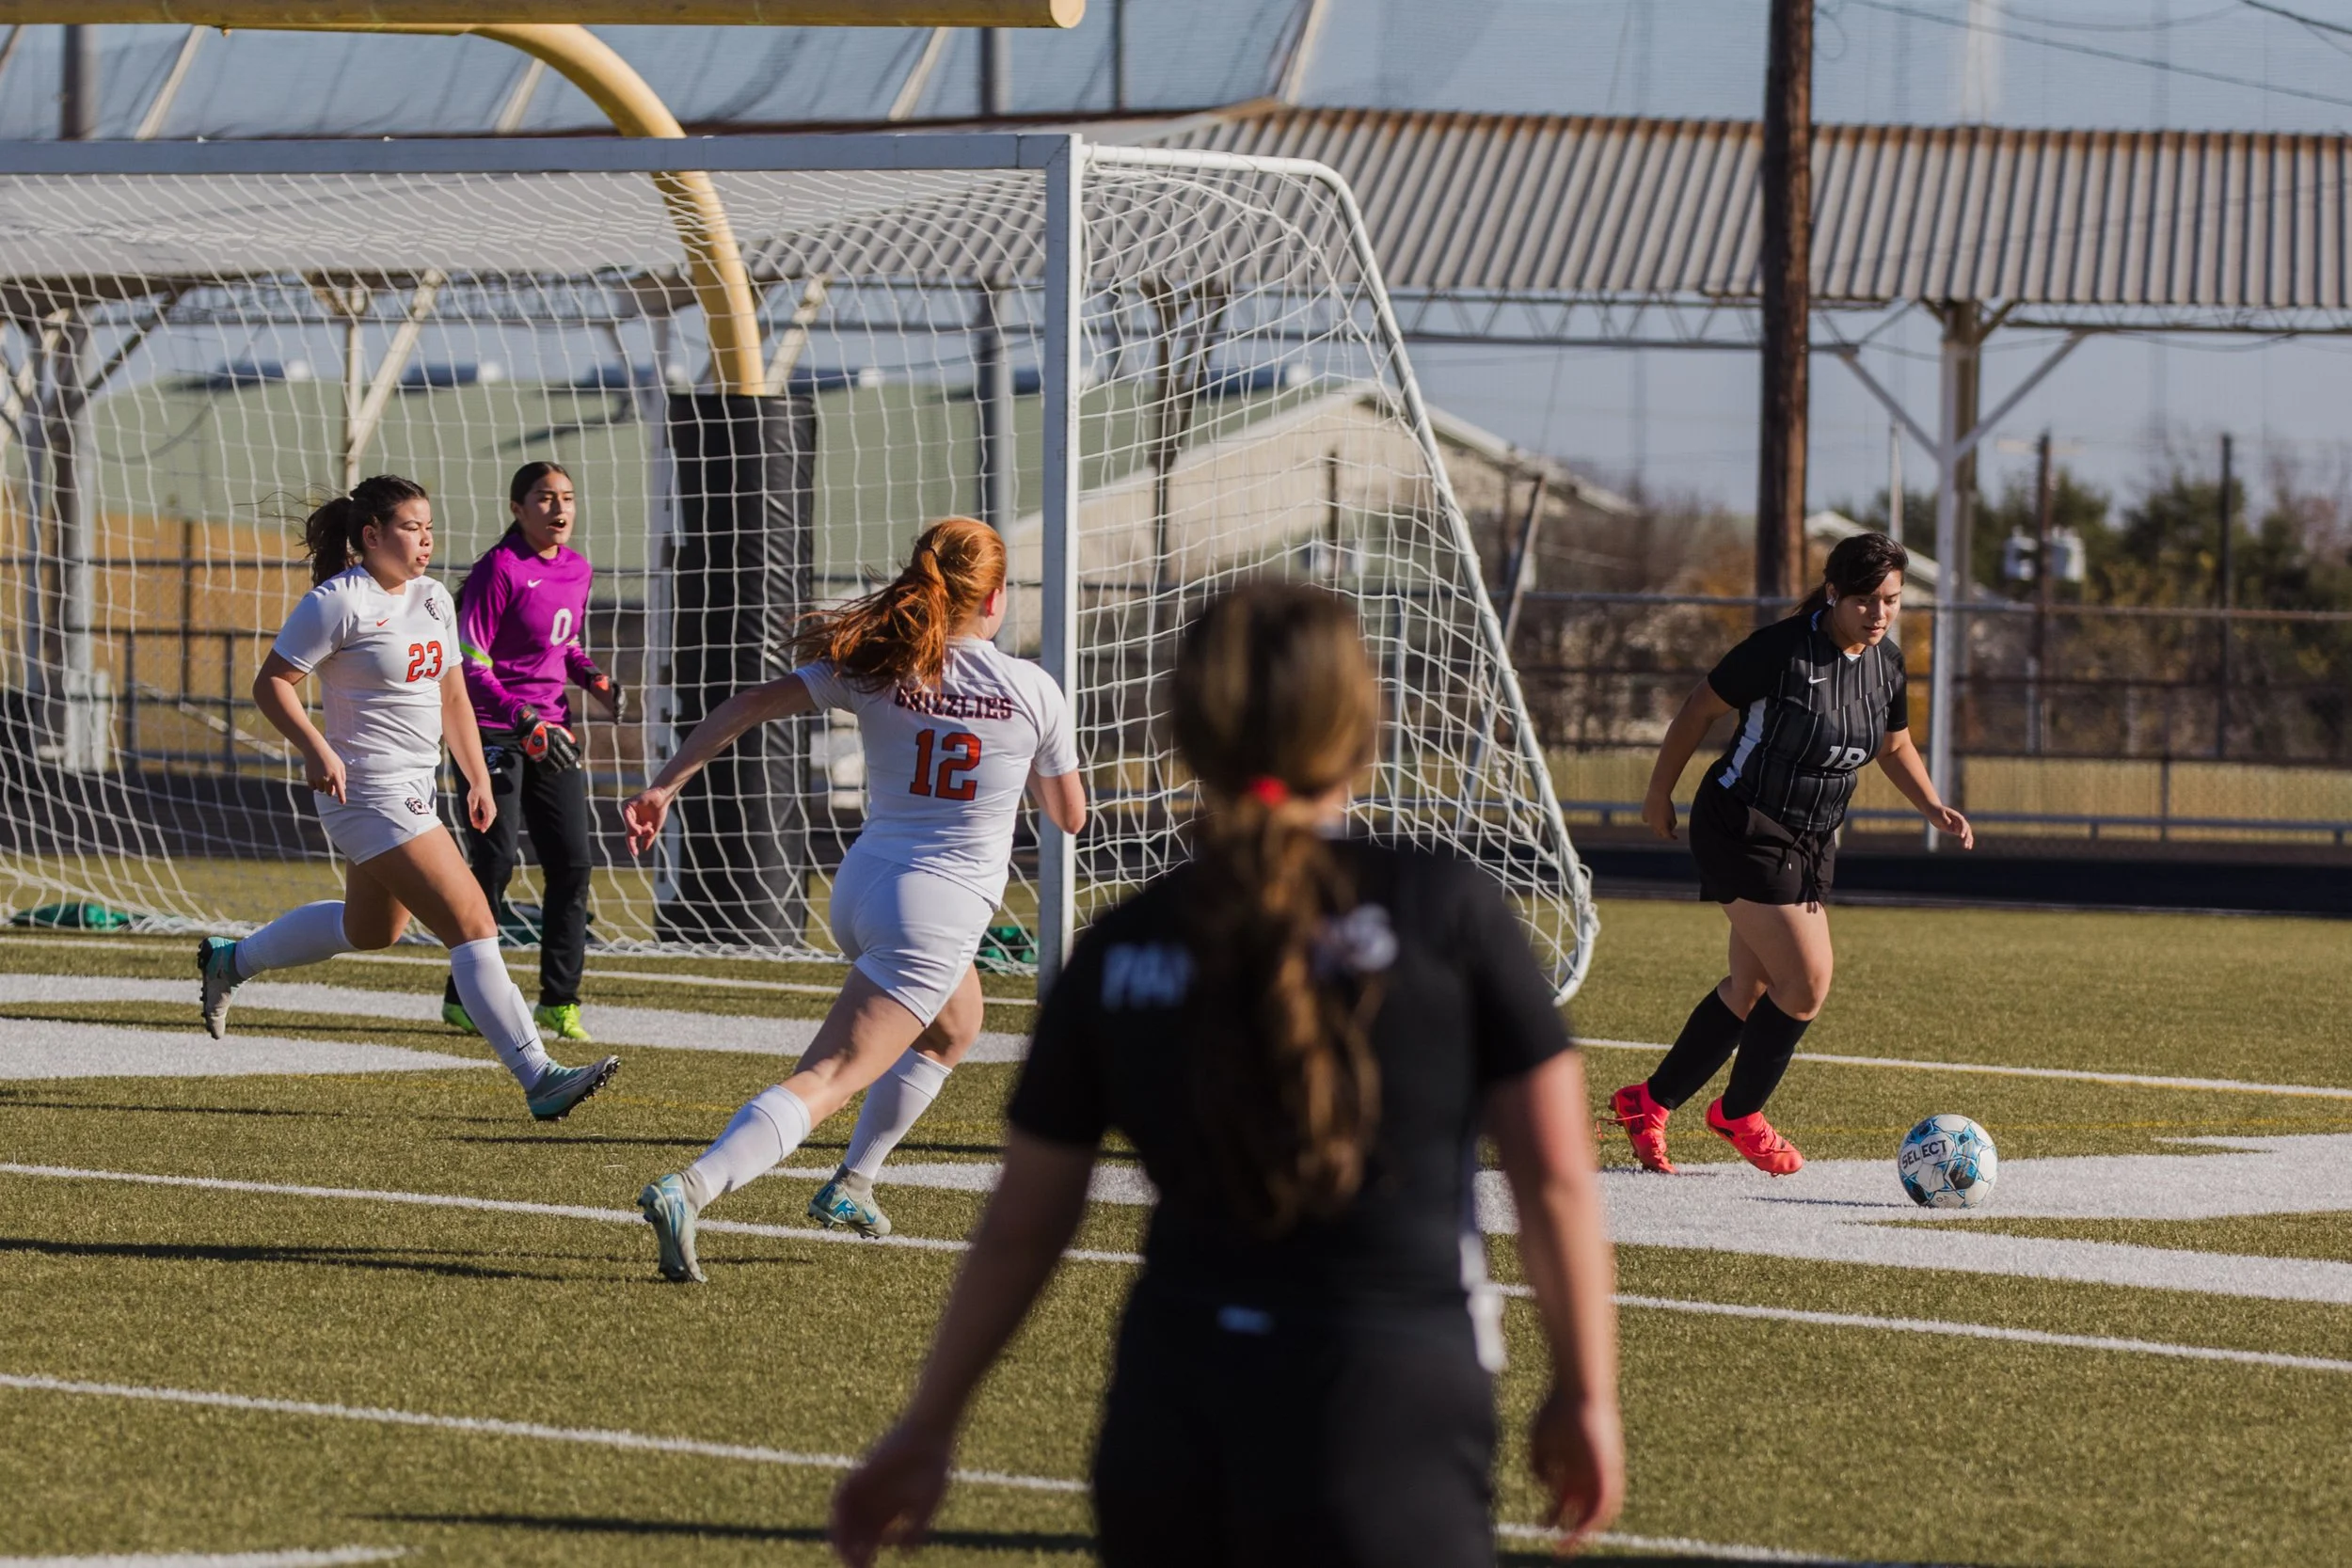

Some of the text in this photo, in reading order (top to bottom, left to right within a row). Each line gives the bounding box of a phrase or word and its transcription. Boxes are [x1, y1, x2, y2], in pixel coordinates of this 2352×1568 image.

[549, 608, 573, 647] 0
[405, 640, 443, 683] 23
[909, 728, 982, 801] 12
[1901, 1139, 1947, 1170] SELECT
